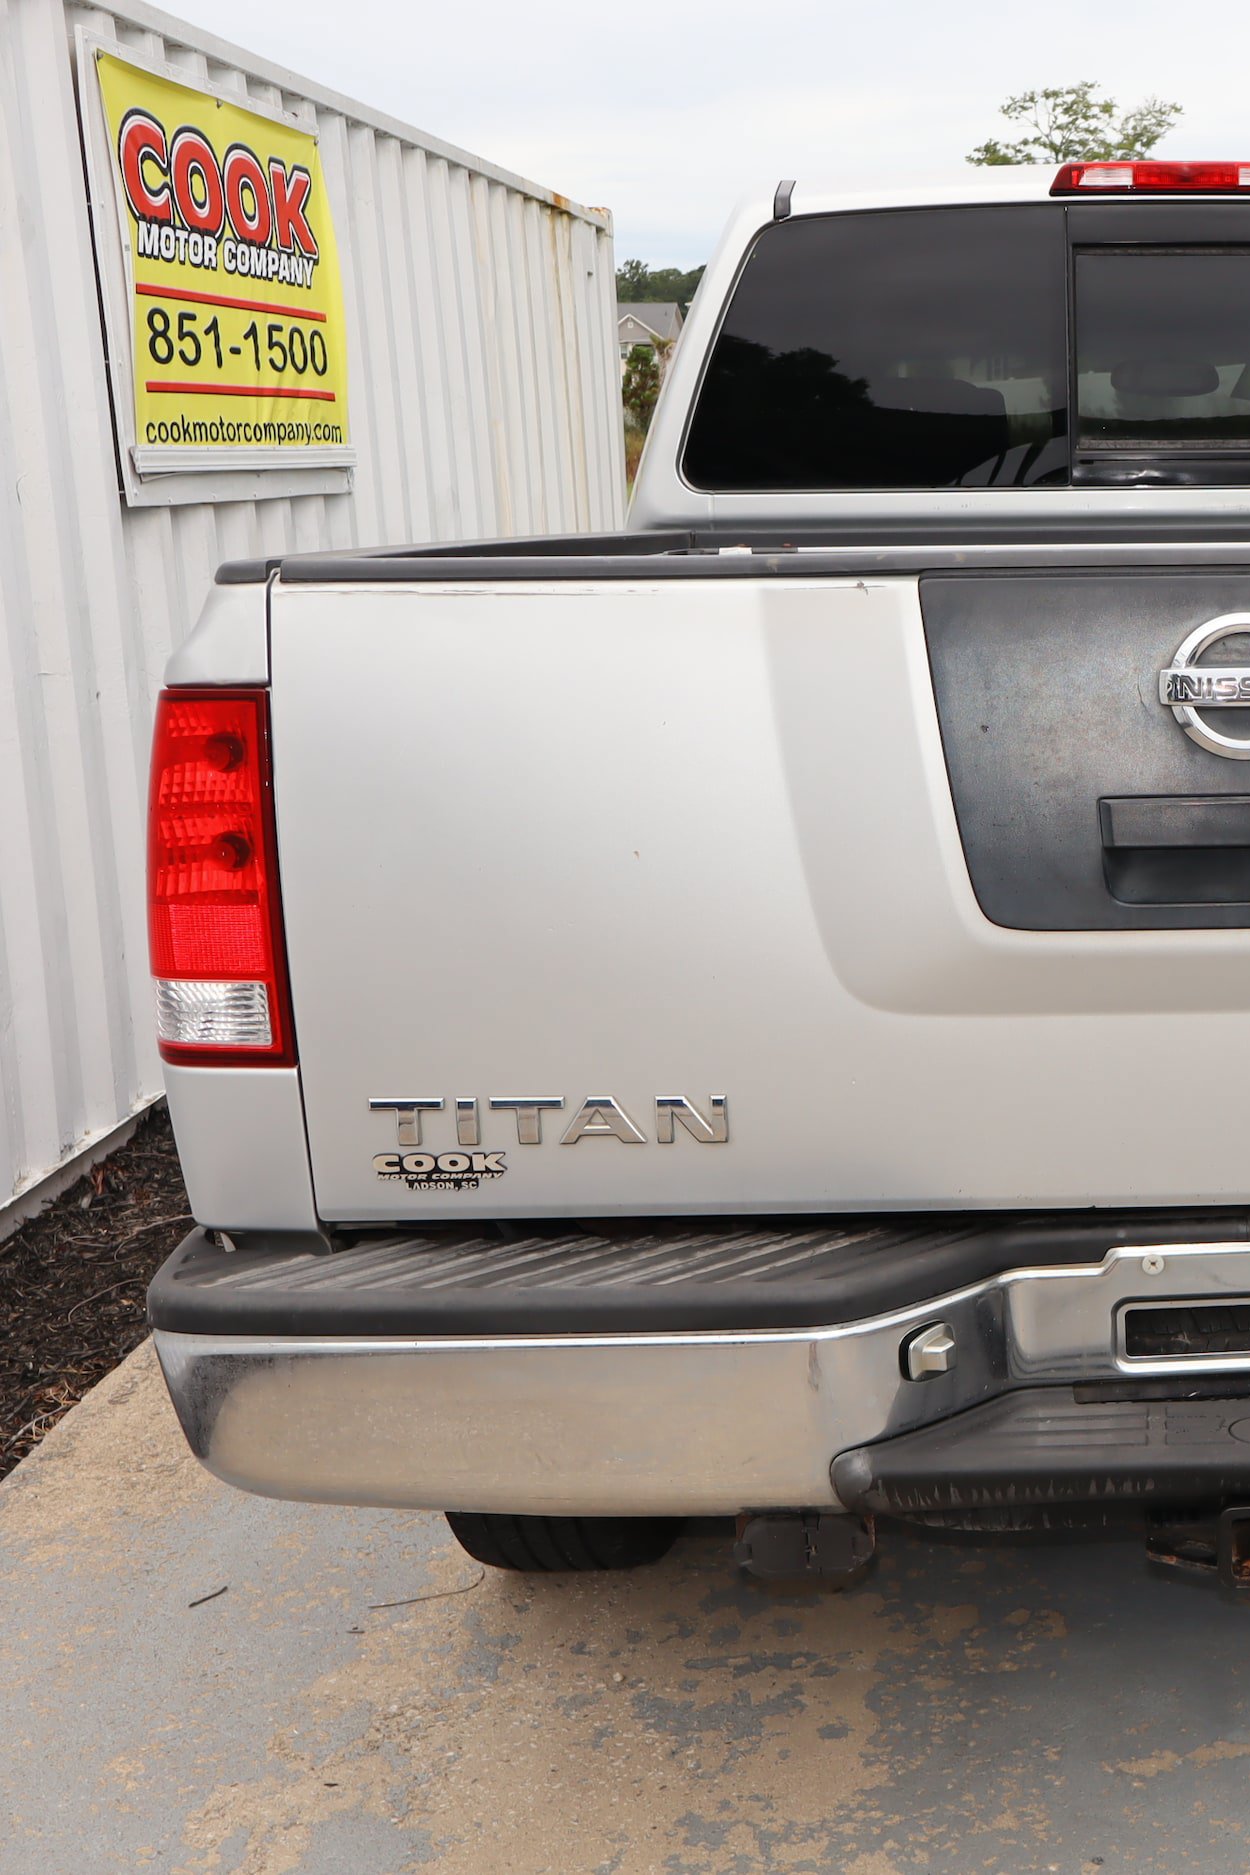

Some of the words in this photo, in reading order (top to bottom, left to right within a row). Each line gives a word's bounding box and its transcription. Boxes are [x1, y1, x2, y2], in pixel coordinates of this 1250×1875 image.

[118, 108, 318, 258] COOK
[138, 220, 217, 269] MOTOR
[223, 238, 317, 288] COMPANY
[147, 307, 328, 377] 851-1500
[145, 414, 343, 446] cookmotorcompany.com
[368, 1095, 730, 1146] TITAN
[372, 1152, 507, 1173] COOK
[377, 1172, 428, 1181] MOTOR
[431, 1171, 504, 1180] COMPANY
[461, 1181, 479, 1190] SC
